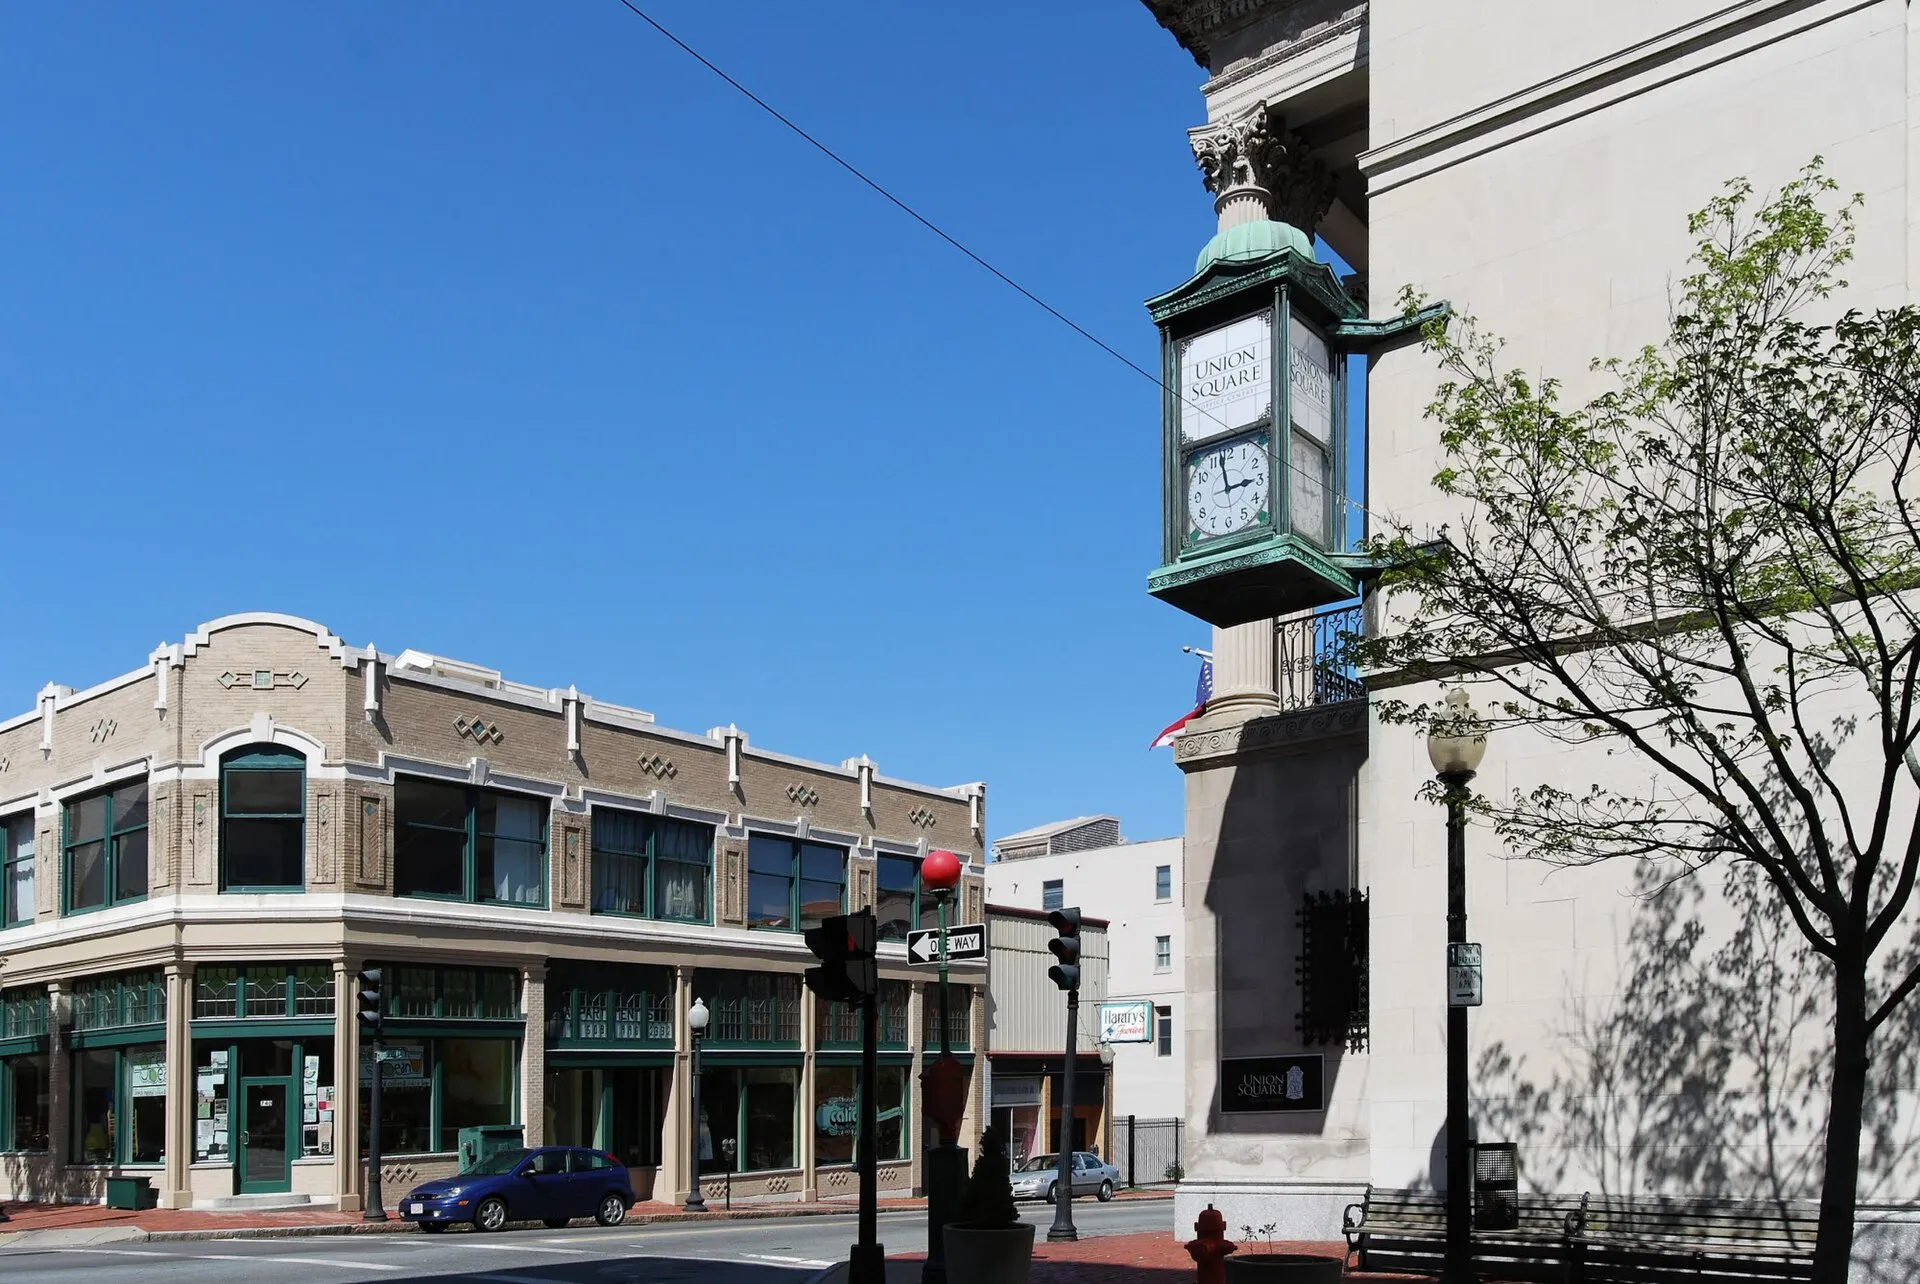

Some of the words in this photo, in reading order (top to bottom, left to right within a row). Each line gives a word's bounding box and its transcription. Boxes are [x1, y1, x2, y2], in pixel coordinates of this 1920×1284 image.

[1196, 346, 1255, 379] UNION
[1292, 347, 1323, 384] UNION
[1191, 364, 1261, 402] SQUARE
[1290, 364, 1325, 405] SQUARE
[1242, 447, 1246, 460] 1
[1210, 456, 1217, 469] 11
[1251, 457, 1259, 470] 2
[1198, 471, 1209, 485] 10
[1256, 472, 1264, 486] 3
[1194, 491, 1202, 503] 9
[1251, 491, 1260, 504] 4
[1198, 507, 1207, 519] 8
[1240, 507, 1248, 520] 5
[1210, 515, 1217, 529] 7
[1225, 516, 1233, 529] 6
[930, 938, 951, 952] OE
[954, 935, 977, 951] WAY
[1458, 955, 1480, 964] PARKING
[1243, 1074, 1284, 1086] UNION
[1237, 1083, 1284, 1098] SQUARE
